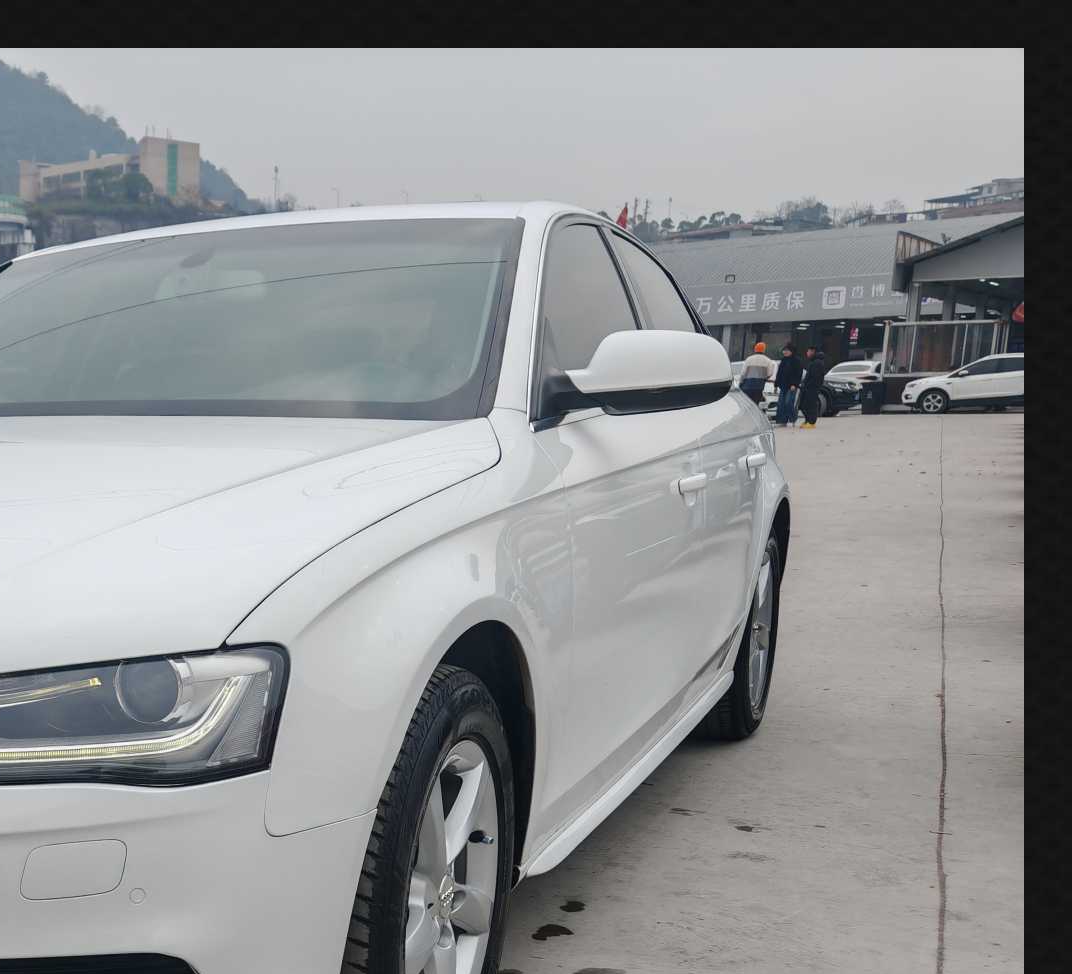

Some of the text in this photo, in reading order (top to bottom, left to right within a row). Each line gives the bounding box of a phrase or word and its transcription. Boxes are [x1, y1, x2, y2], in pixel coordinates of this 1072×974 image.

[696, 290, 805, 314] 万公里质保
